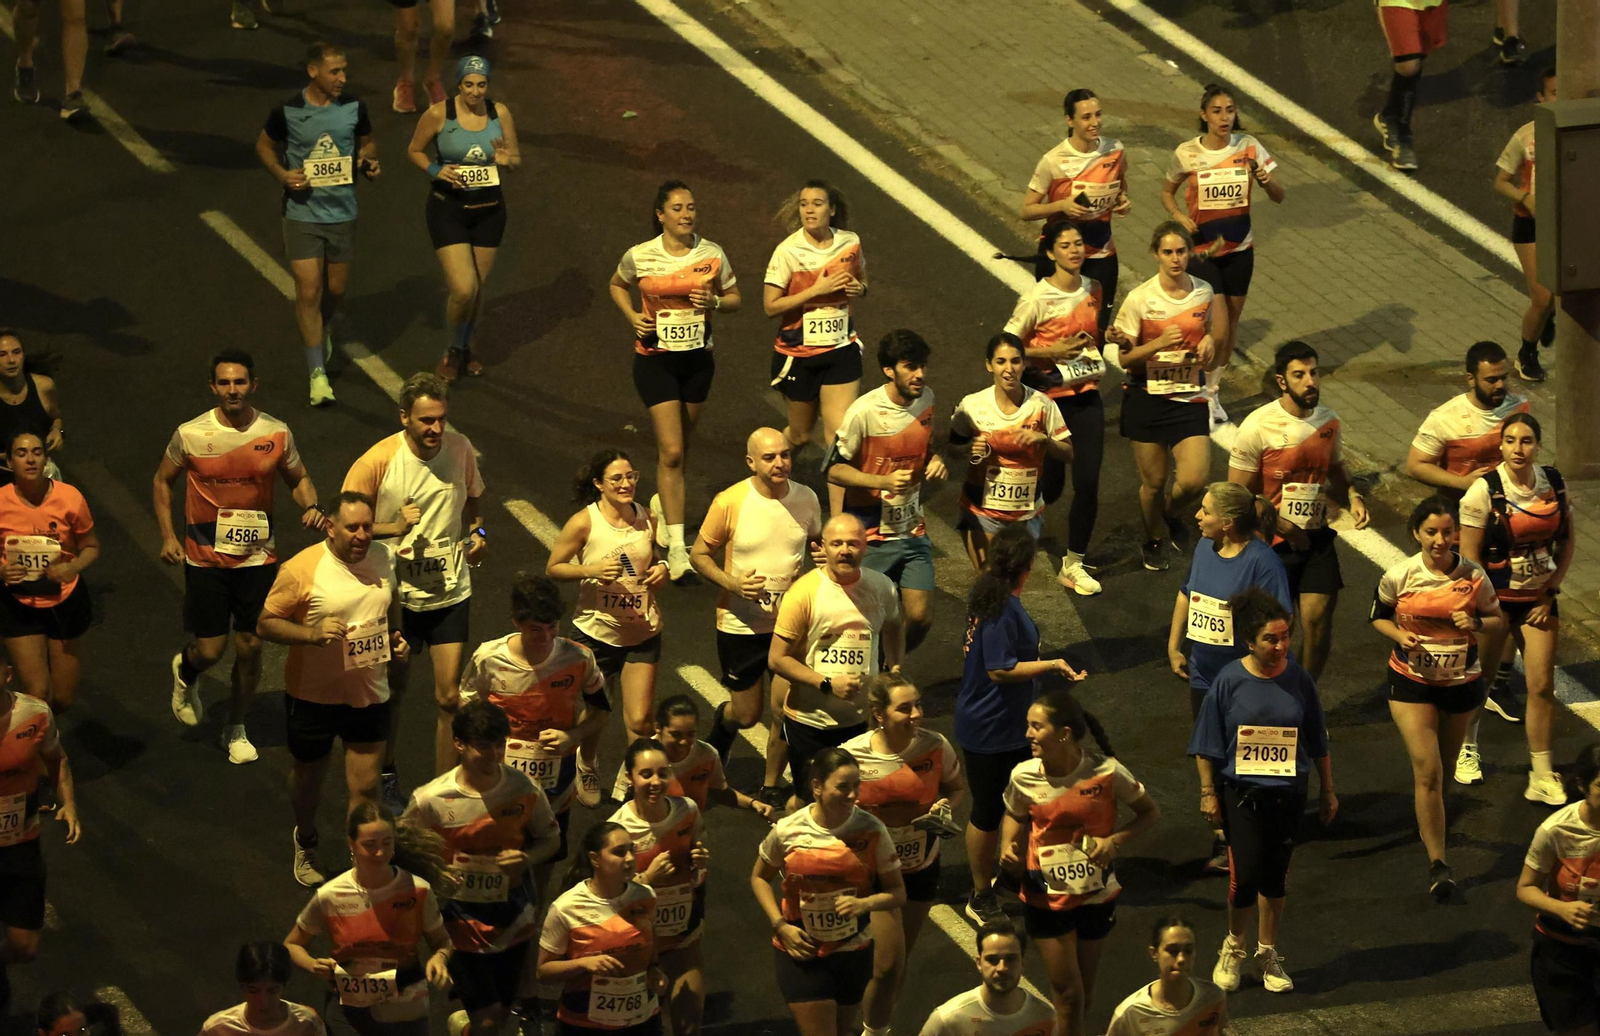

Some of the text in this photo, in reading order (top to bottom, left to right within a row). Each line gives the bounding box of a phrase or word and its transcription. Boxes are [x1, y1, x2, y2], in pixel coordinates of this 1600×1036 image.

[313, 162, 342, 176] 3864
[461, 169, 490, 184] 6983
[1204, 185, 1242, 198] 10402
[662, 324, 700, 343] 15317
[809, 318, 845, 334] 21390
[1154, 366, 1190, 381] 14717
[990, 484, 1030, 499] 13104
[225, 528, 258, 543] 4586
[407, 557, 448, 577] 17442
[602, 593, 642, 609] 17445
[1191, 612, 1226, 633] 23763
[349, 635, 384, 656] 23419
[821, 648, 864, 665] 23585
[1416, 654, 1460, 668] 19777
[1243, 746, 1288, 761] 21030
[511, 759, 553, 777] 11991
[896, 841, 920, 857] 999
[1049, 862, 1096, 881] 19596
[341, 977, 389, 994] 23133
[596, 996, 641, 1012] 24768
